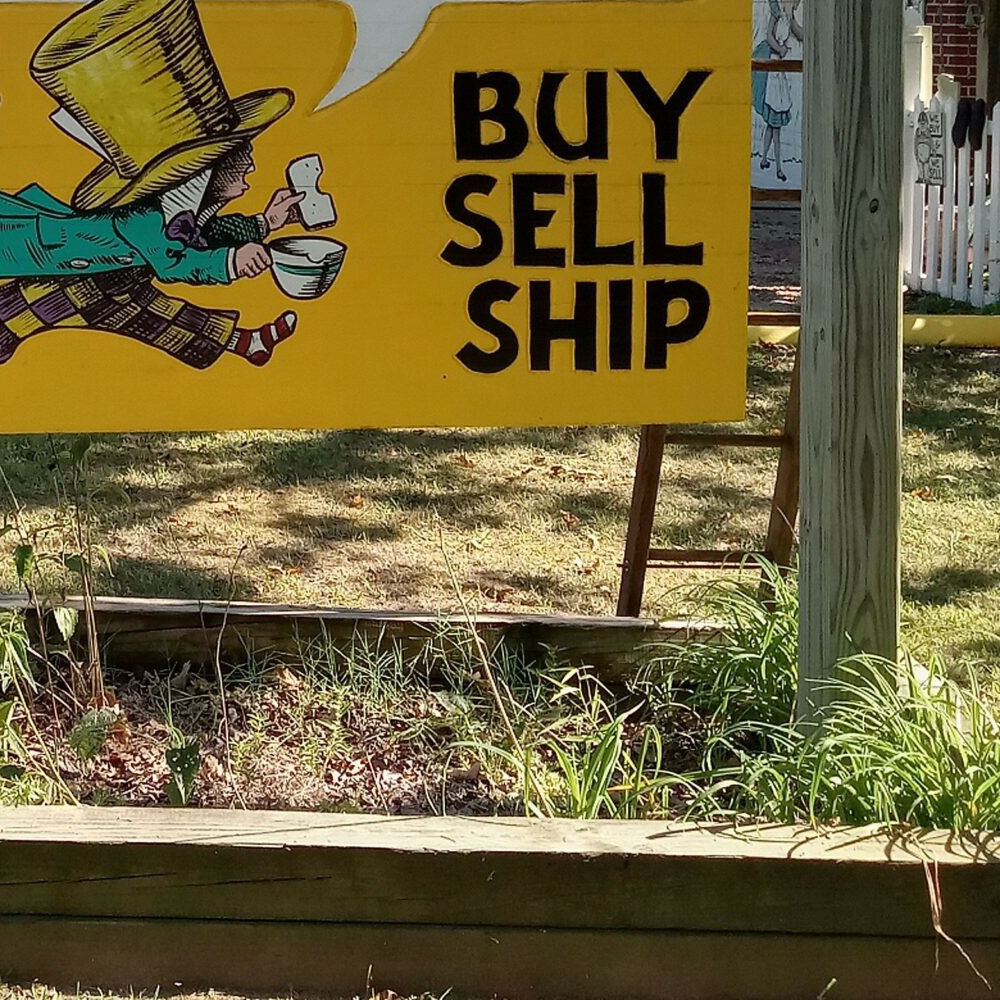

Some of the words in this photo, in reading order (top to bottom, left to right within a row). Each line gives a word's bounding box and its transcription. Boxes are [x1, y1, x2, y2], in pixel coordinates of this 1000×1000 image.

[454, 68, 714, 161] BUY
[440, 171, 704, 268] SELL
[455, 278, 711, 374] SHIP
